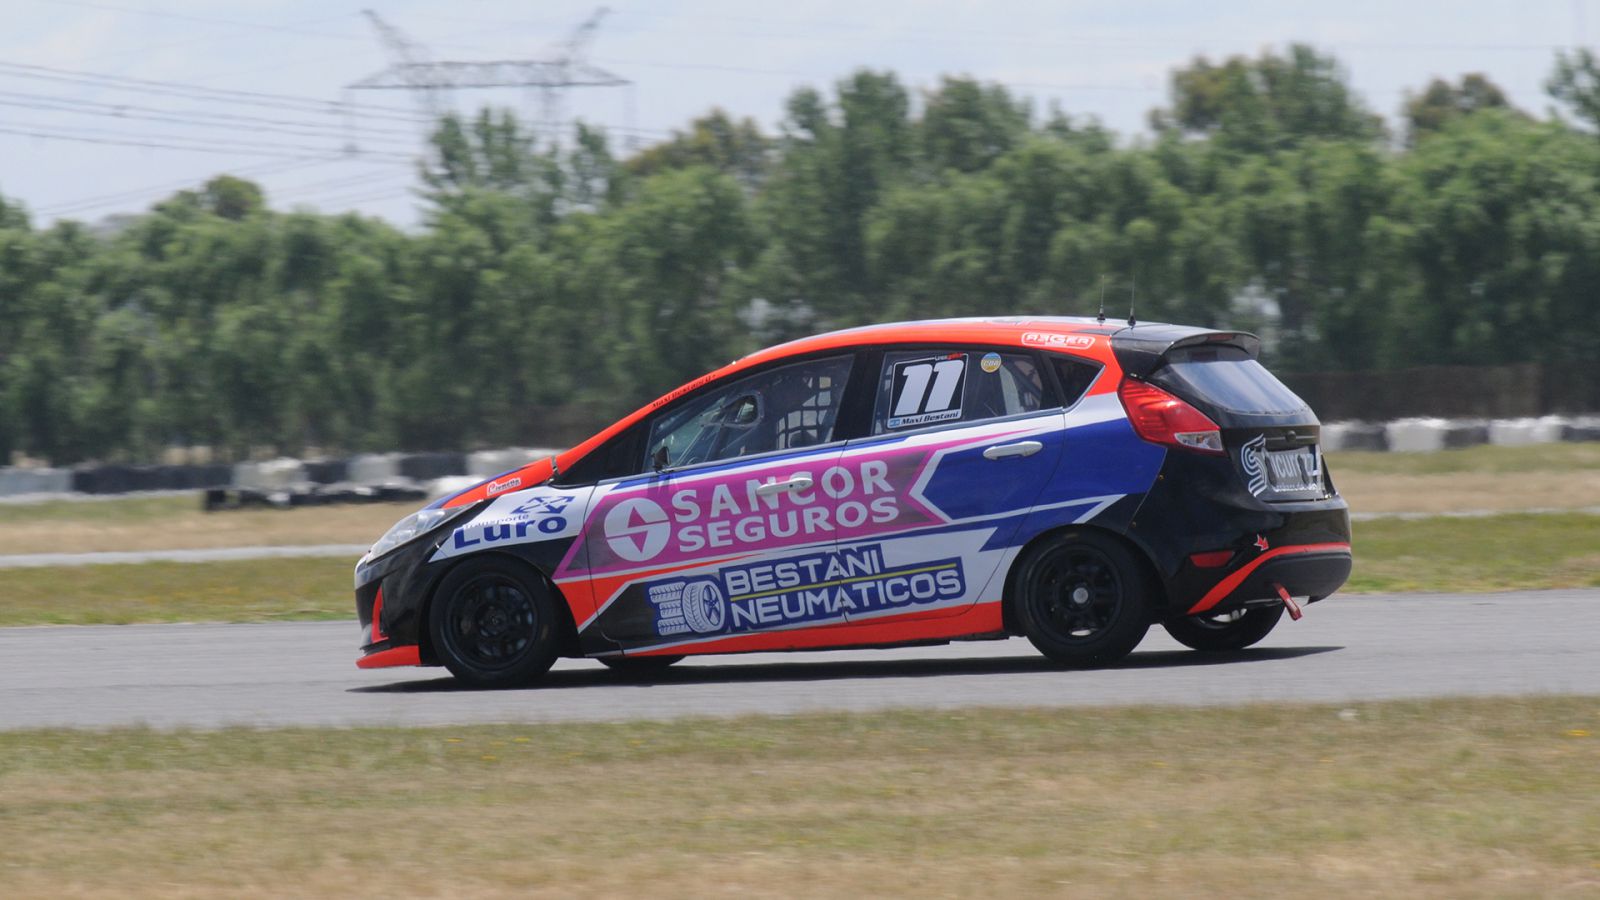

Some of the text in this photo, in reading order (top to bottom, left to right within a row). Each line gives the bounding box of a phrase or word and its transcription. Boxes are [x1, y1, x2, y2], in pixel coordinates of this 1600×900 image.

[894, 360, 964, 416] 11
[901, 411, 959, 425] Maxi Bestani
[671, 460, 895, 523] SANCOR
[454, 516, 567, 549] Luro
[677, 497, 899, 552] SEGUROS
[725, 550, 880, 596] BESTANI
[731, 570, 961, 627] NEUMATICOS
